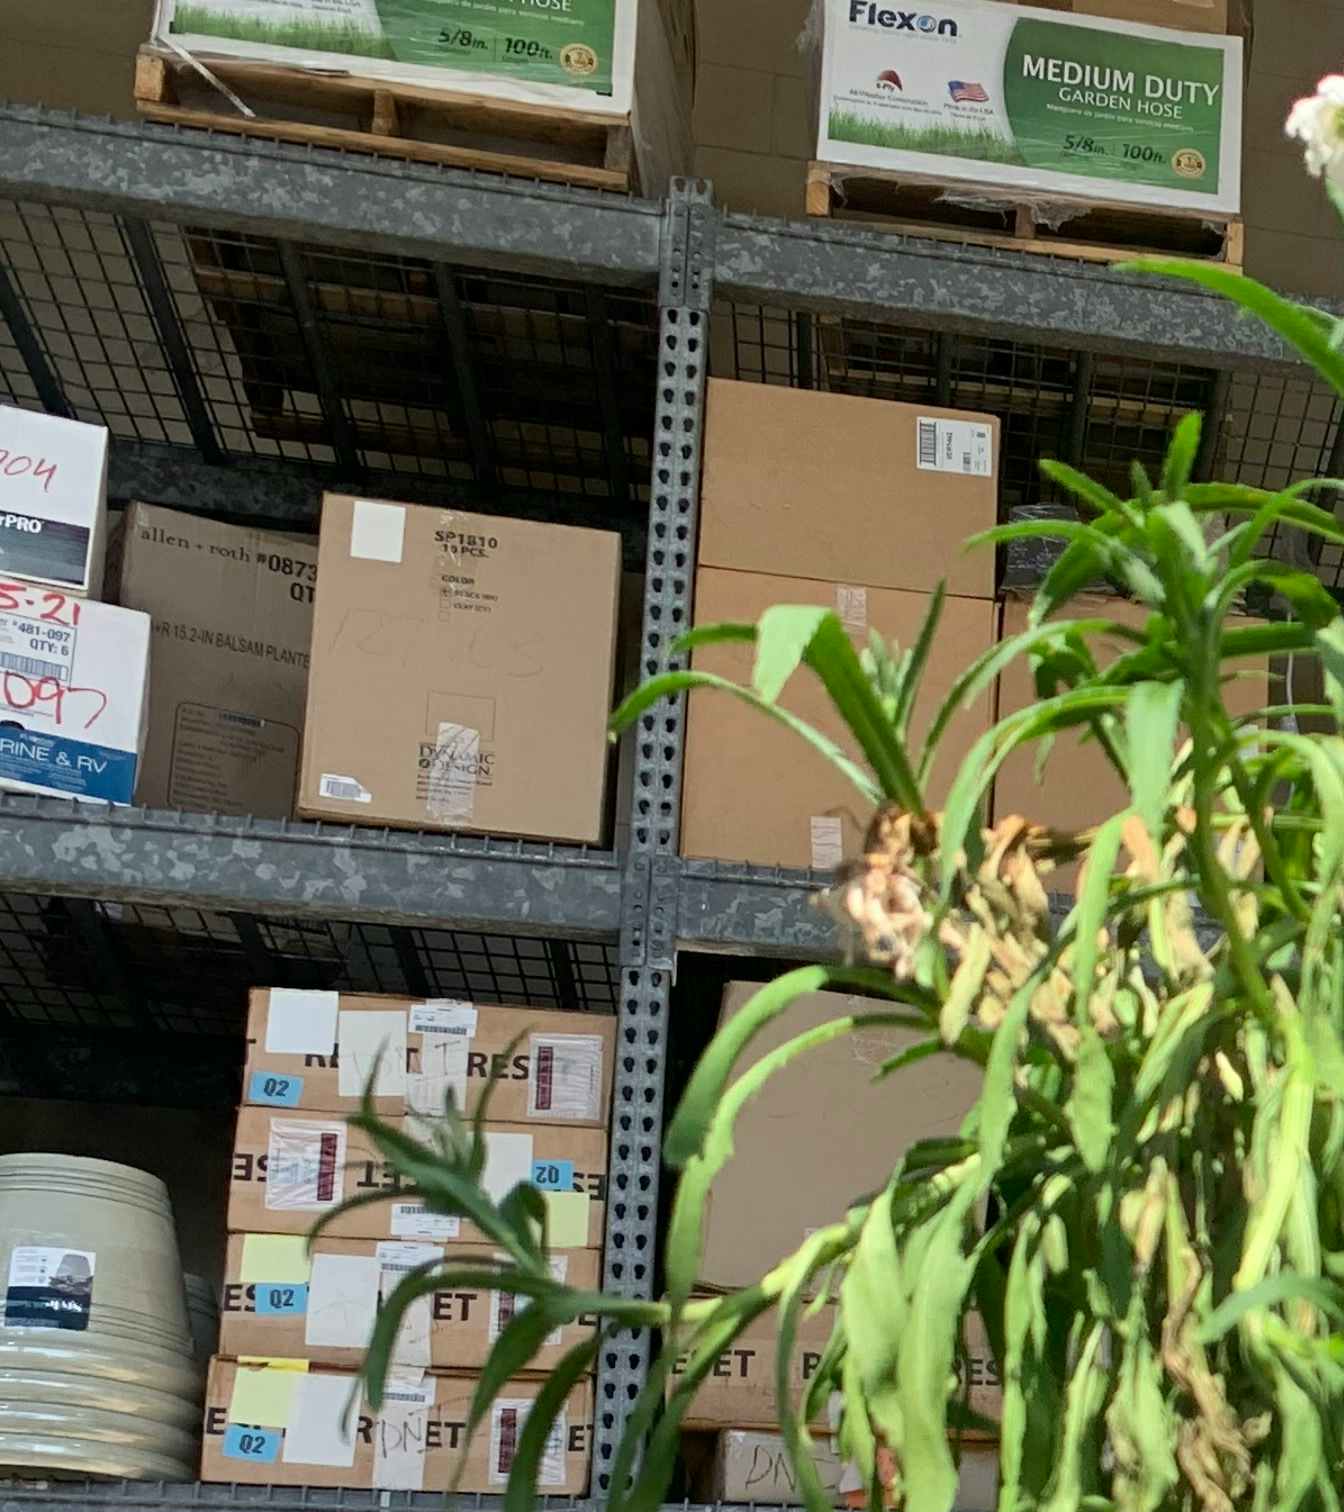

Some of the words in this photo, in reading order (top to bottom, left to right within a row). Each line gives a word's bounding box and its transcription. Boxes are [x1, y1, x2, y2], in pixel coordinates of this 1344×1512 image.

[848, 0, 959, 37] Flexon
[1022, 53, 1136, 95] MEDIUM
[1144, 73, 1220, 106] DUTY
[1058, 87, 1132, 111] GARDEN
[1136, 99, 1184, 120] HOSE
[140, 527, 190, 550] allen
[209, 545, 251, 563] roth
[215, 632, 263, 657] BALSAM
[55, 752, 71, 767] &
[77, 755, 108, 774] RV
[263, 1078, 290, 1097] Q2
[269, 1289, 295, 1309] Q2
[239, 1434, 266, 1455] Q2
